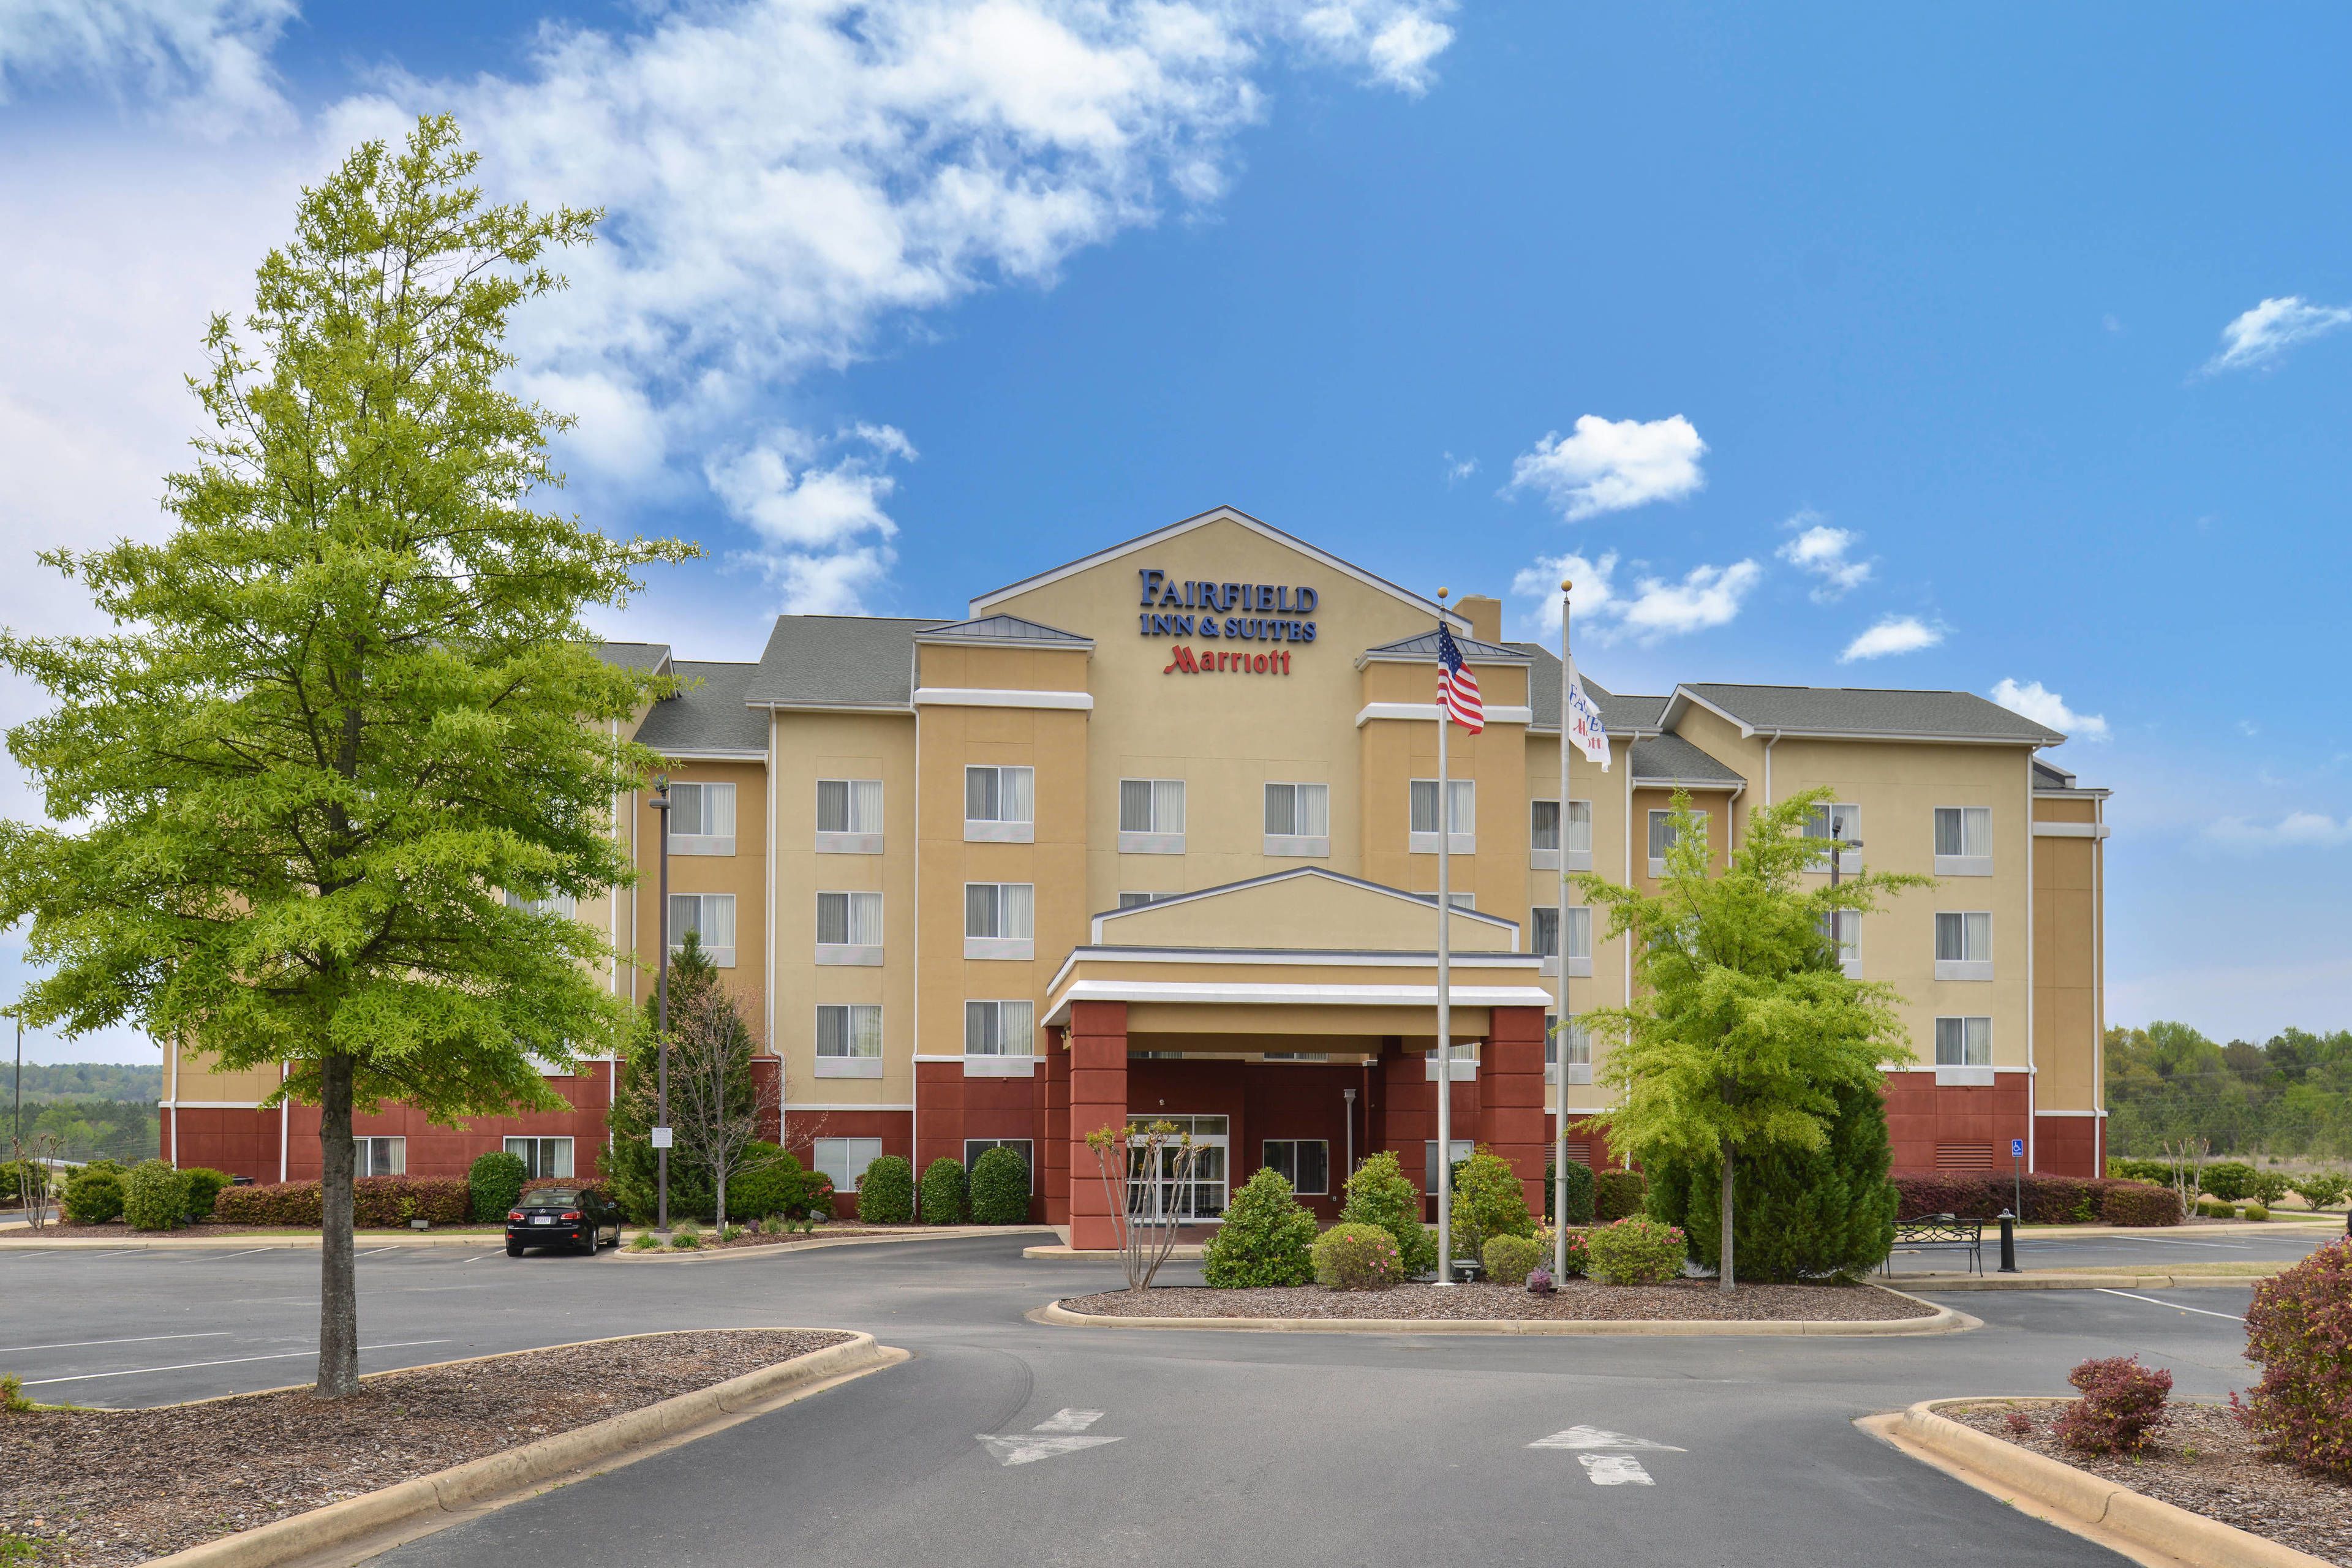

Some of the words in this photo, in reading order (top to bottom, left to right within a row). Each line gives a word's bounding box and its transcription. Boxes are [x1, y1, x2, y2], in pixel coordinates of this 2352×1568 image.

[1139, 568, 1318, 613] FAIRFIELD
[1140, 613, 1195, 636] INN
[1199, 616, 1220, 638] &
[1224, 617, 1317, 643] SUITES
[1163, 644, 1291, 675] Marriott
